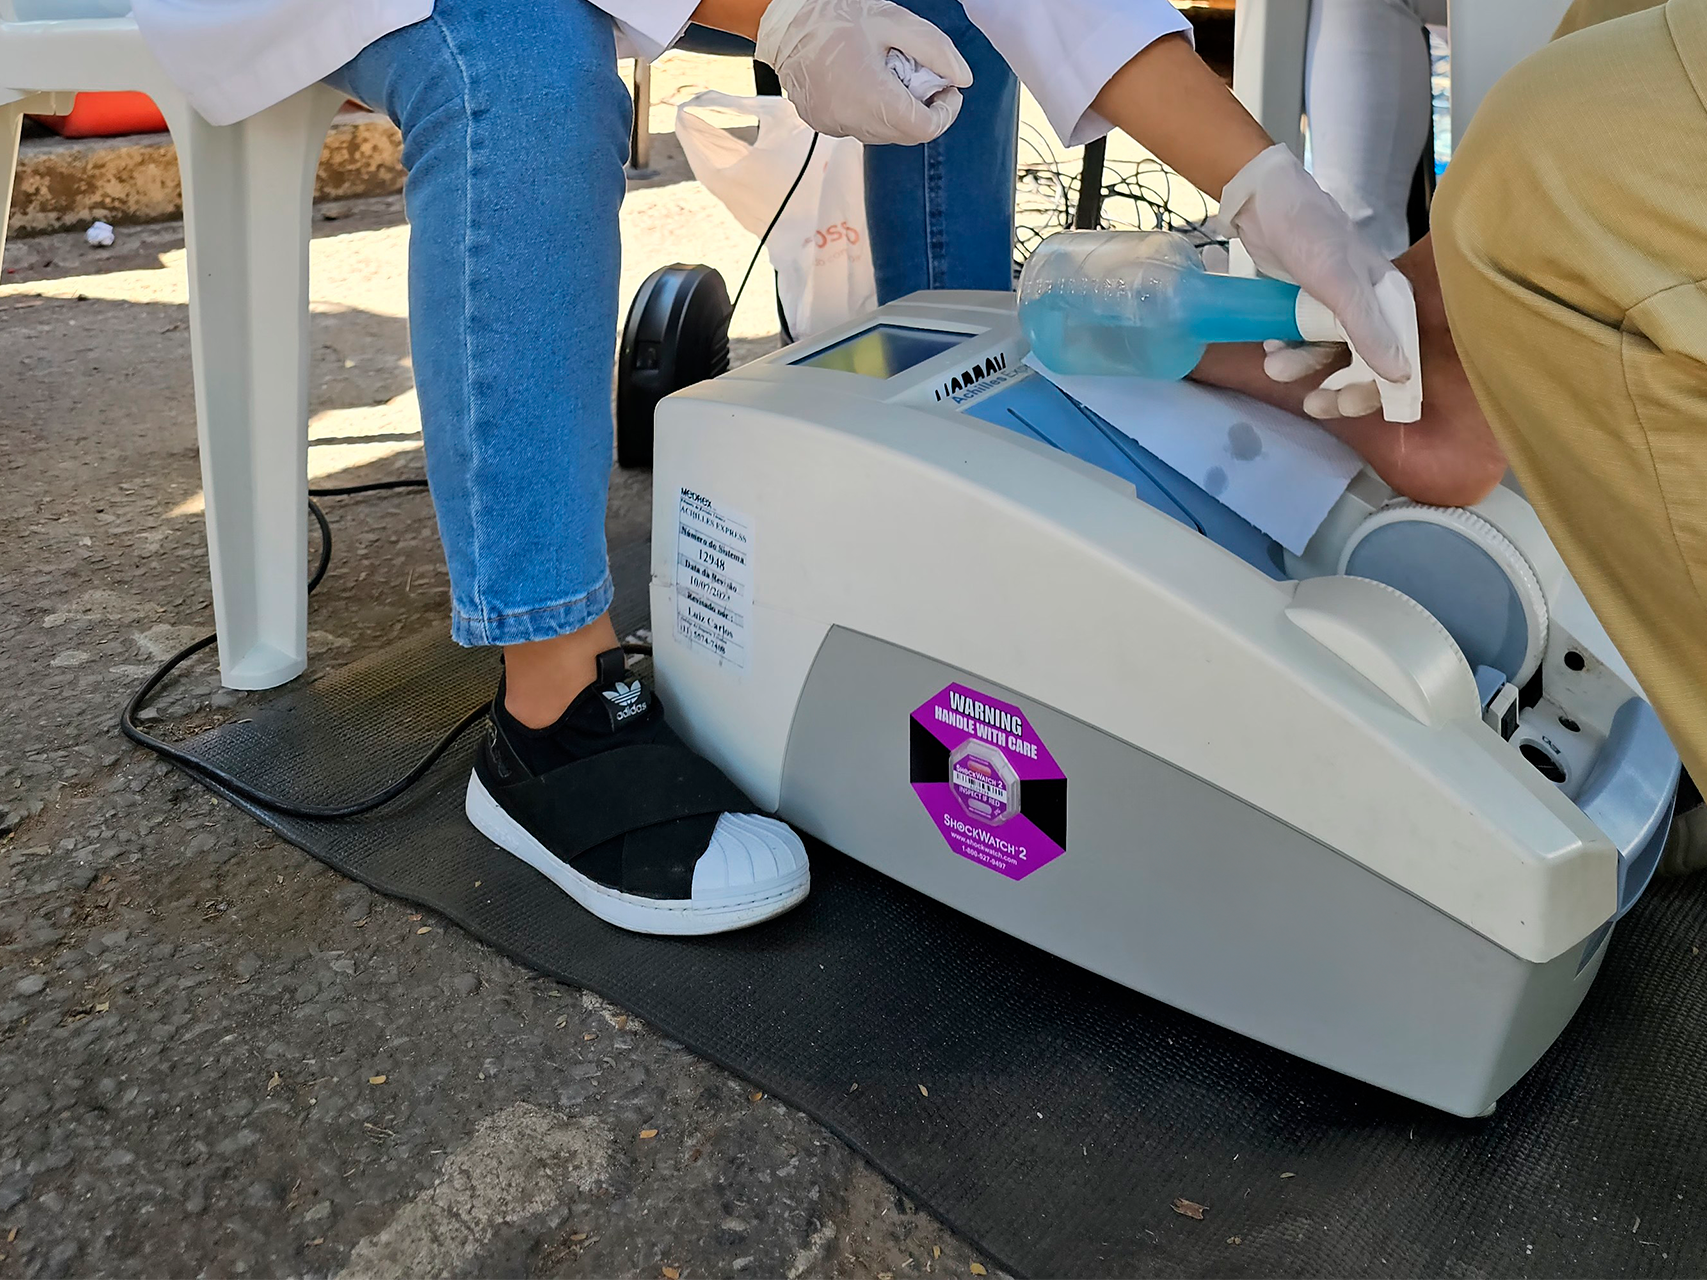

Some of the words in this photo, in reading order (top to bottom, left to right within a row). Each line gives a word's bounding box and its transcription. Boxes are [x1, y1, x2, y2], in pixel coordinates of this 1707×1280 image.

[951, 375, 1008, 404] Achilles
[680, 505, 715, 528] ACHILLES
[715, 522, 747, 543] EXPRESS
[680, 525, 708, 546] Número
[708, 539, 717, 550] do
[718, 544, 745, 565] Sistema
[699, 549, 725, 571] 12948
[684, 559, 701, 574] Data
[711, 572, 737, 593] Revisão
[687, 591, 716, 613] Revisado
[688, 606, 706, 623] Luiz
[707, 617, 734, 639] Carlos
[616, 702, 647, 721] adidas
[949, 690, 1022, 737] WARNING
[934, 705, 975, 734] HANDLE
[976, 722, 1006, 748] WITH
[1008, 735, 1038, 760] CARE
[959, 786, 982, 800] INSPECT
[989, 796, 1001, 807] RED
[950, 831, 1018, 865] www.shockwatch.com
[1018, 846, 1027, 861] 2
